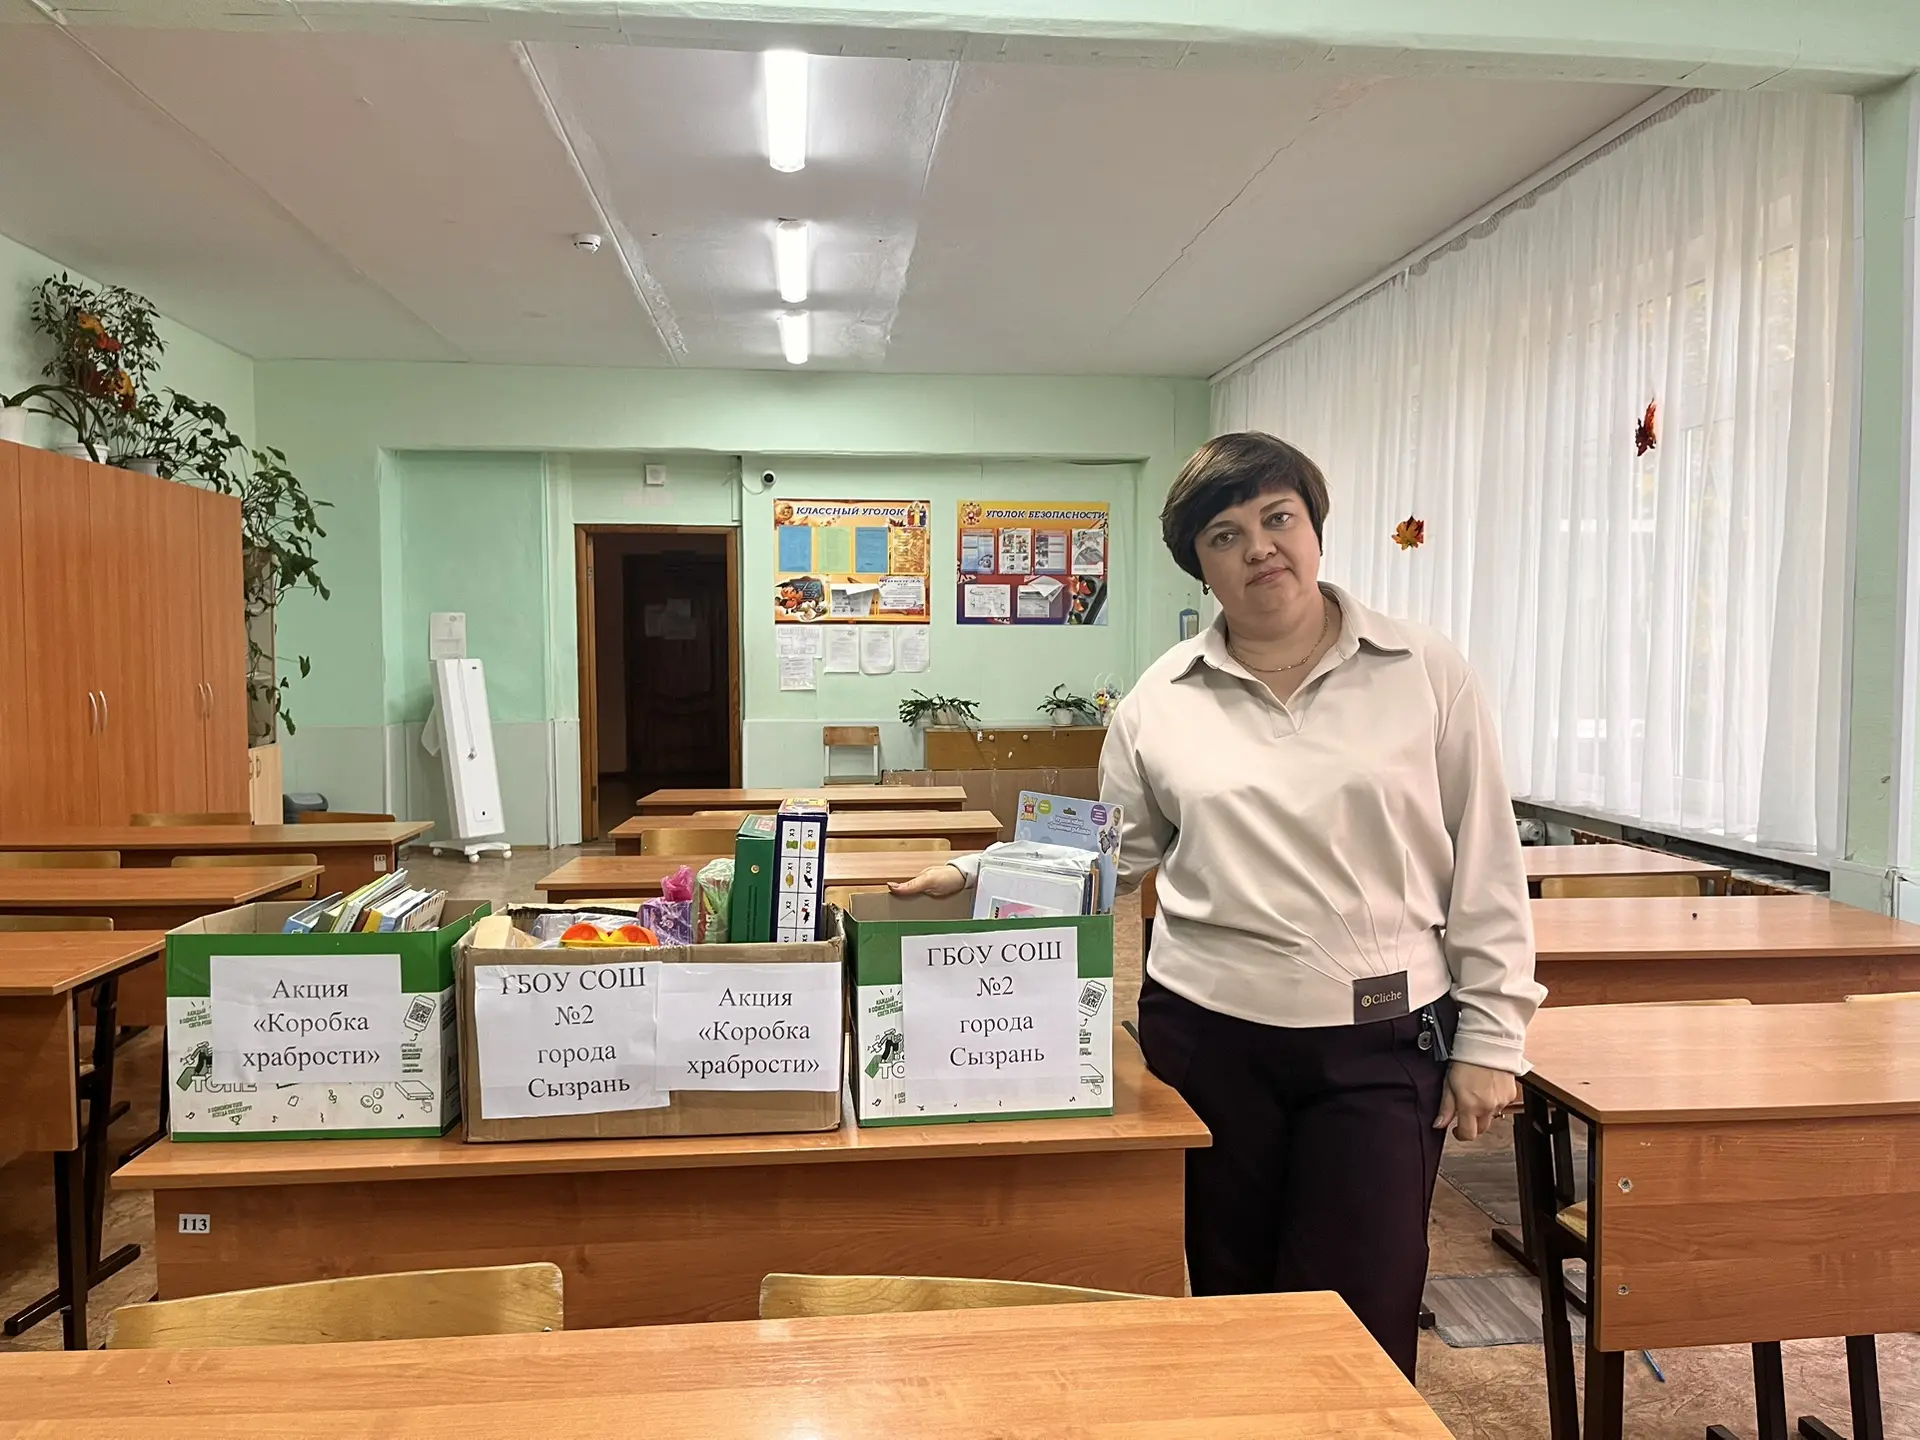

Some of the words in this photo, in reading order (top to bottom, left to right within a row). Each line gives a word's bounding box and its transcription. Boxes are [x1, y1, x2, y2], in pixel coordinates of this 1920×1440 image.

[796, 505, 860, 516] КЛАССНЫЙ
[861, 508, 906, 516] УГОЛОК
[986, 510, 1025, 518] УГОЛОК
[1028, 511, 1105, 519] БЕЗОПАСНОСТИ
[927, 944, 994, 967] ГБОУ
[1000, 941, 1062, 964] СОШ
[272, 978, 349, 1001] Акция
[501, 971, 571, 996] ГБОУ
[579, 966, 645, 991] СОШ
[976, 976, 1014, 997] №2
[718, 987, 793, 1008] Акция
[1371, 990, 1402, 1004] Cliche
[253, 1011, 370, 1037] «Коробка
[555, 1004, 594, 1026] №2
[960, 1015, 1034, 1038] города
[699, 1019, 811, 1045] «Коробка
[242, 1046, 380, 1072] храбрости»
[537, 1044, 617, 1068] города
[687, 1053, 820, 1079] храбрости»
[949, 1046, 1045, 1070] Сызрань
[528, 1077, 630, 1101] Сызрань
[182, 1217, 207, 1231] 113
